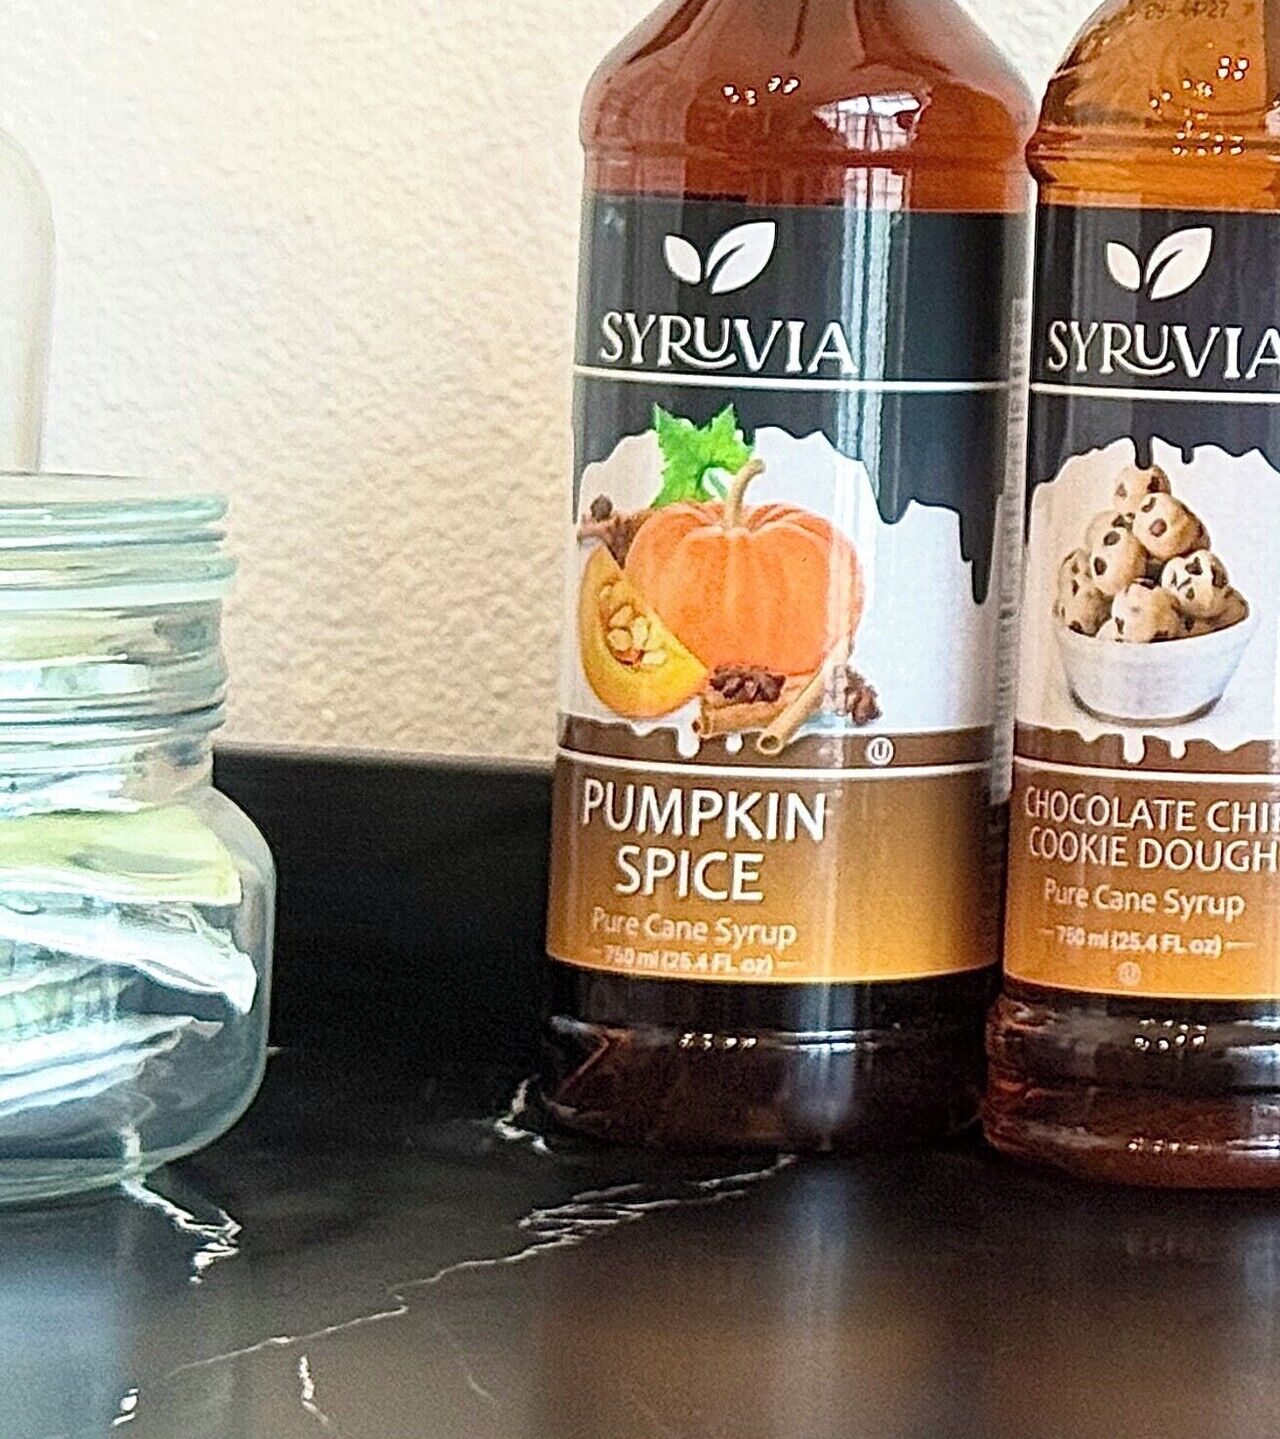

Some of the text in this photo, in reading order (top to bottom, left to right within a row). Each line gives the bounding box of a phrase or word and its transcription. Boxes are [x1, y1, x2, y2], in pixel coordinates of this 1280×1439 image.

[600, 310, 859, 375] SYRUVIA
[582, 777, 825, 841] PUMPKIN
[1025, 786, 1197, 832] CHOCOLATE
[614, 844, 765, 902] SPICE
[1029, 825, 1279, 873] COOKIE DOUGH
[1044, 877, 1246, 923] Pure Cane Syrup
[591, 906, 797, 951] Pure Cane Syrup
